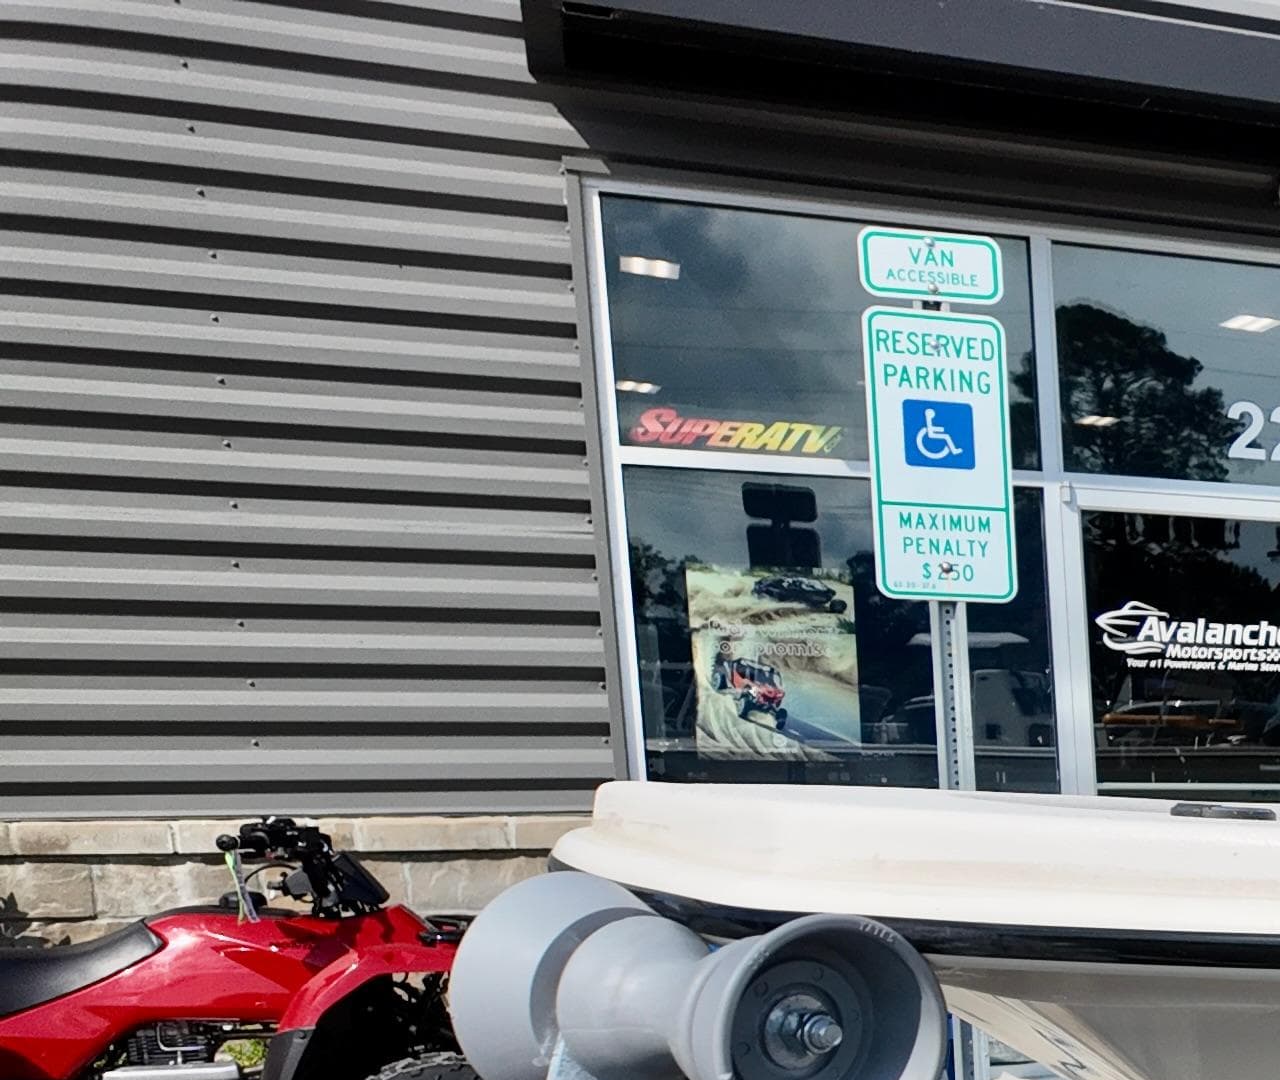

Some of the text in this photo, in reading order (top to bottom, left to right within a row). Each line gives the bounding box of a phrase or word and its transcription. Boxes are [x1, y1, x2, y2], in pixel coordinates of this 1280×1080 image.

[908, 246, 955, 267] VAN
[885, 268, 979, 287] ACCESSIBLE
[875, 329, 995, 362] RESERVED
[883, 363, 991, 395] PARKING
[899, 511, 991, 533] MAXIMUM
[903, 536, 988, 558] PENALTY
[1165, 643, 1268, 662] Motorsports
